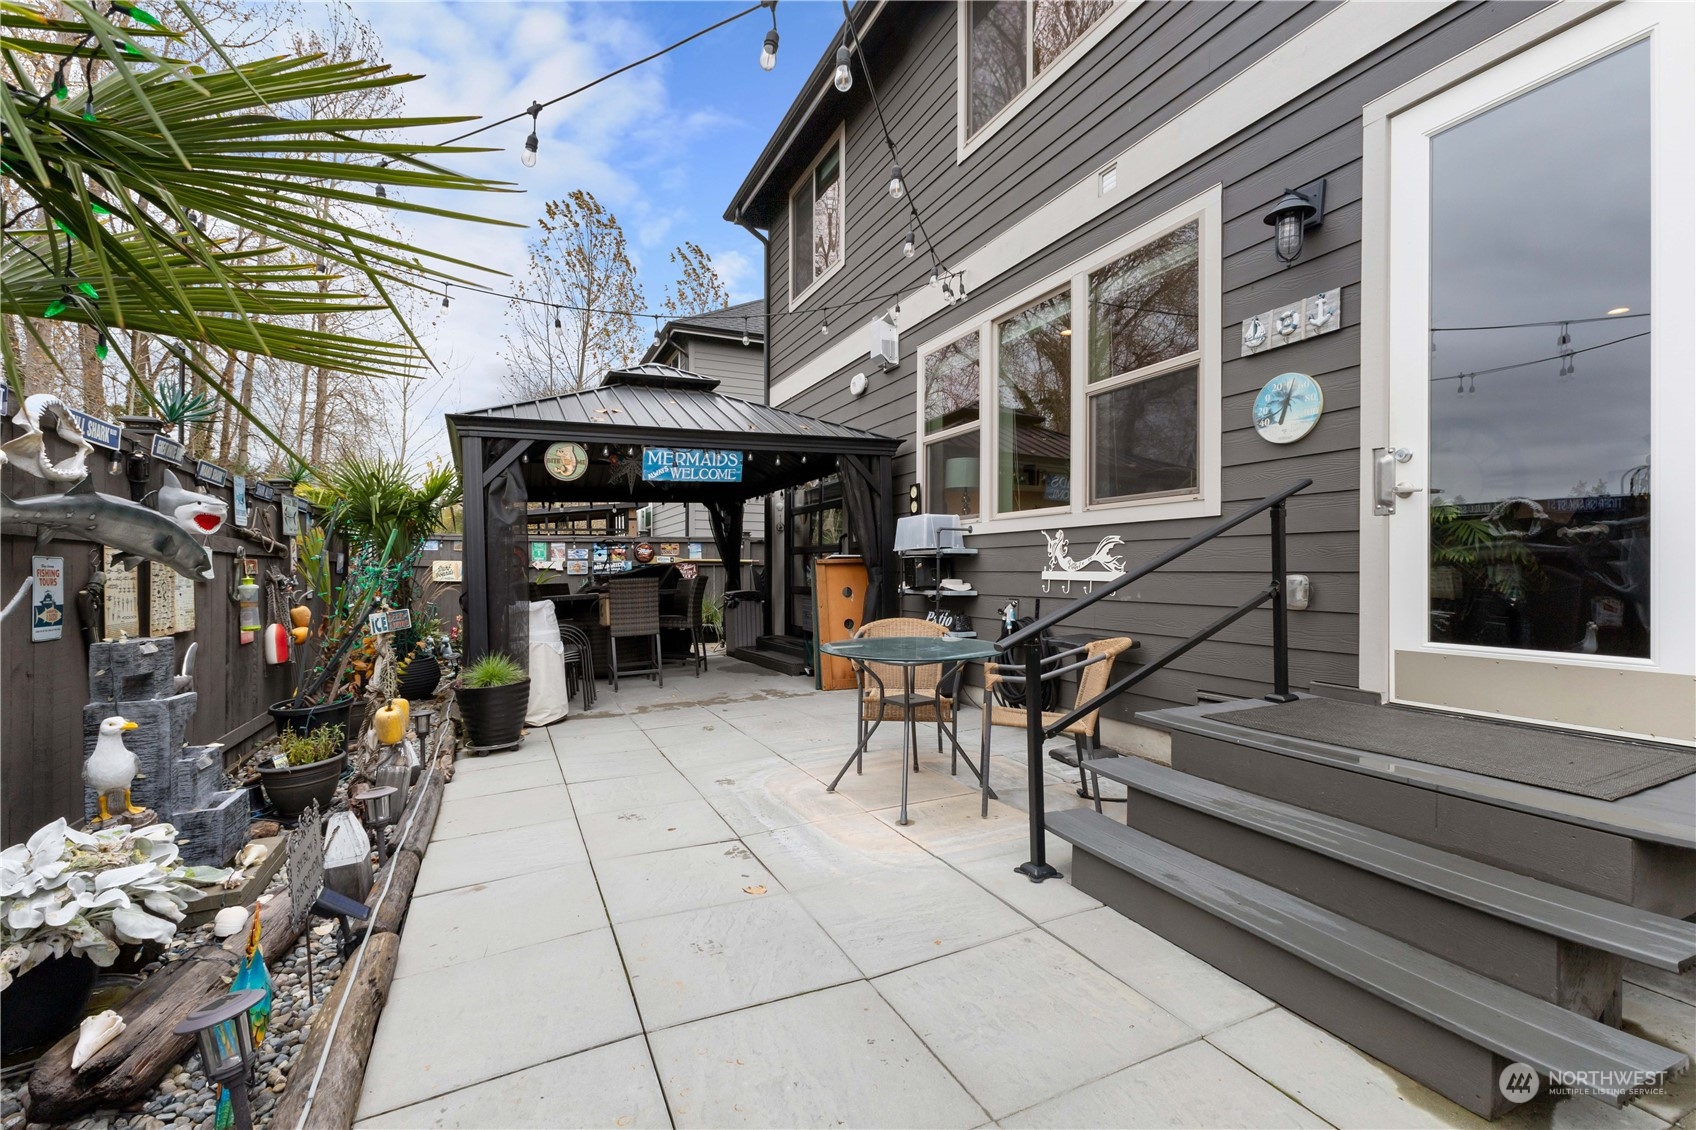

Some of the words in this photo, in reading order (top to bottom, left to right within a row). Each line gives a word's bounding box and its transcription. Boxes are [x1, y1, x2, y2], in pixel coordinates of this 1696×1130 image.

[1272, 383, 1282, 391] 20
[86, 420, 110, 444] SHARK
[647, 451, 738, 466] MERMAIDS
[648, 466, 669, 480] ALWAYS
[670, 467, 736, 480] WELCOME
[36, 569, 60, 578] FISHING
[38, 578, 58, 586] TOURS
[372, 616, 388, 634] ICE
[926, 611, 952, 626] Patio
